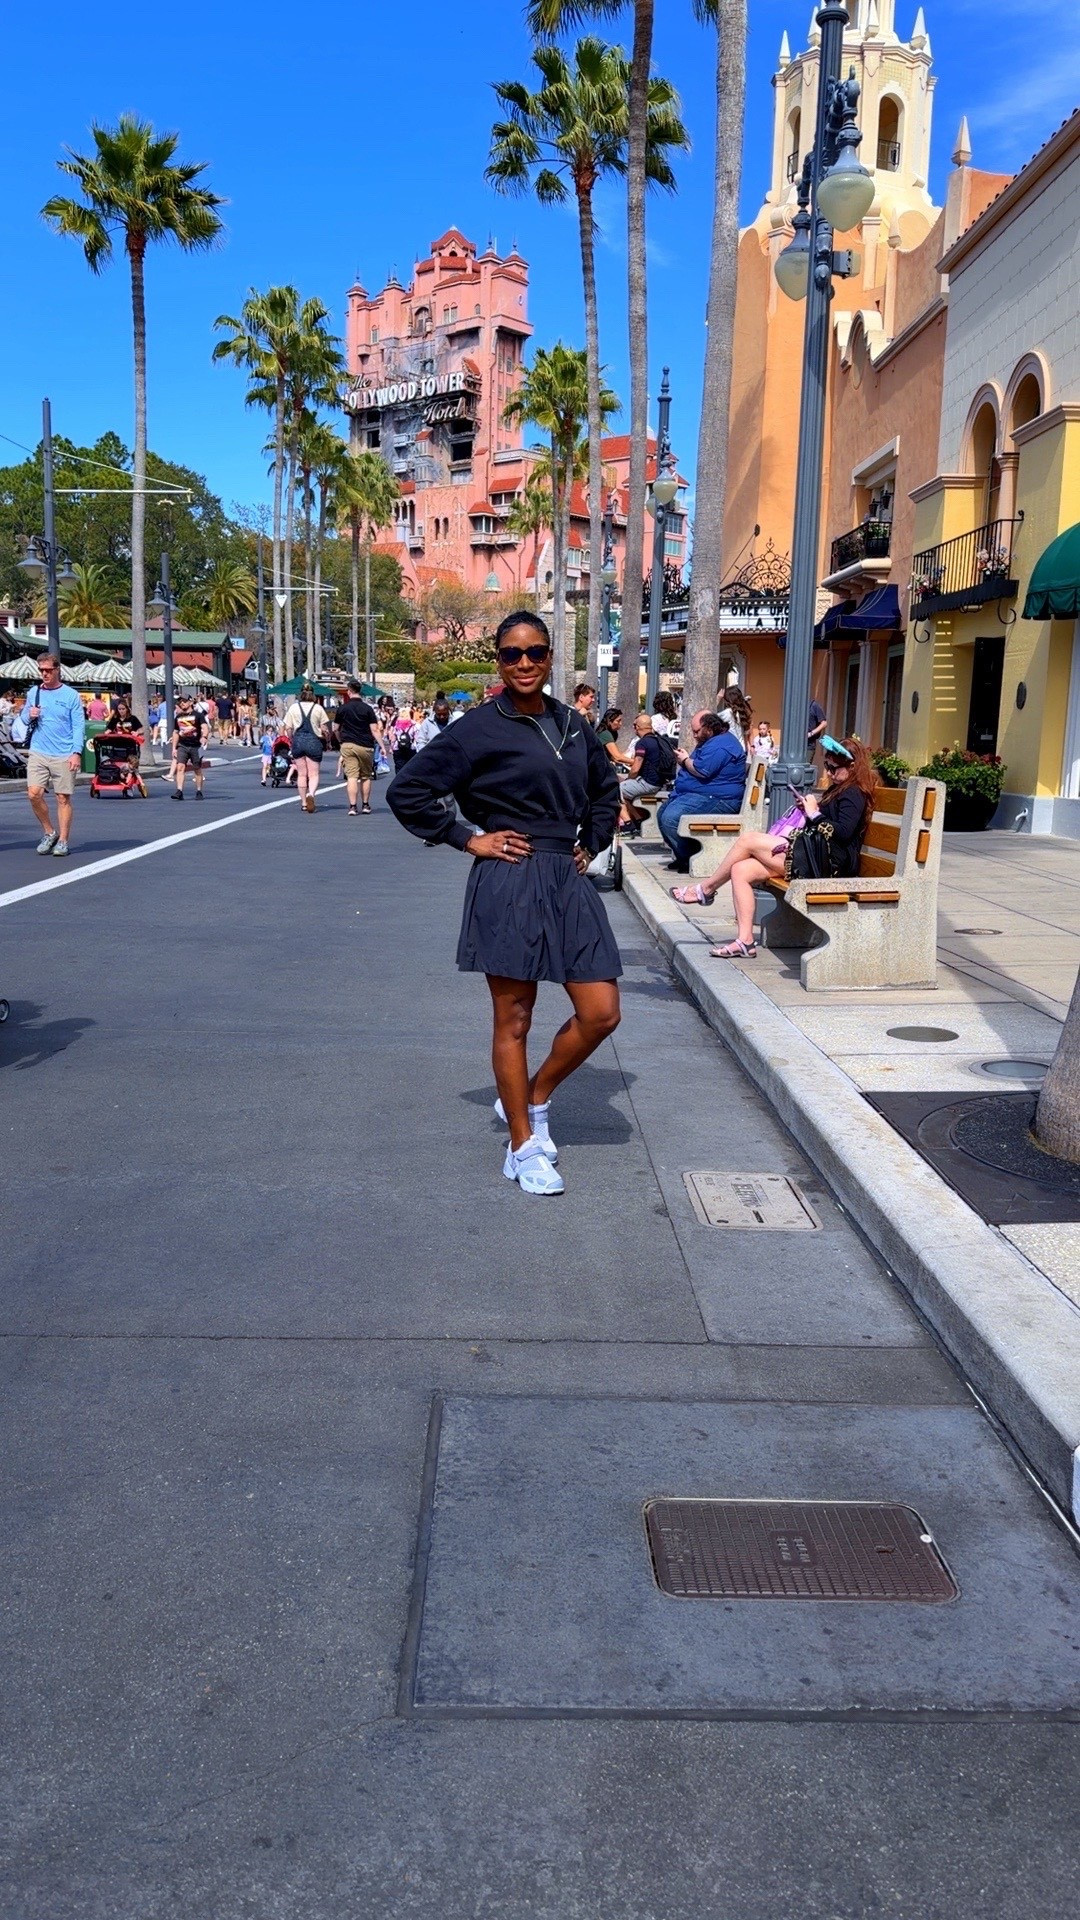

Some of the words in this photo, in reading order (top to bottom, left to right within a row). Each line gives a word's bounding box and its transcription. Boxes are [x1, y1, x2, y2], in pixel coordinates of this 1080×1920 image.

[351, 373, 372, 389] The
[420, 372, 465, 396] TOWER
[422, 397, 465, 423] Hotel
[731, 606, 760, 617] ONCE
[756, 617, 764, 627] A
